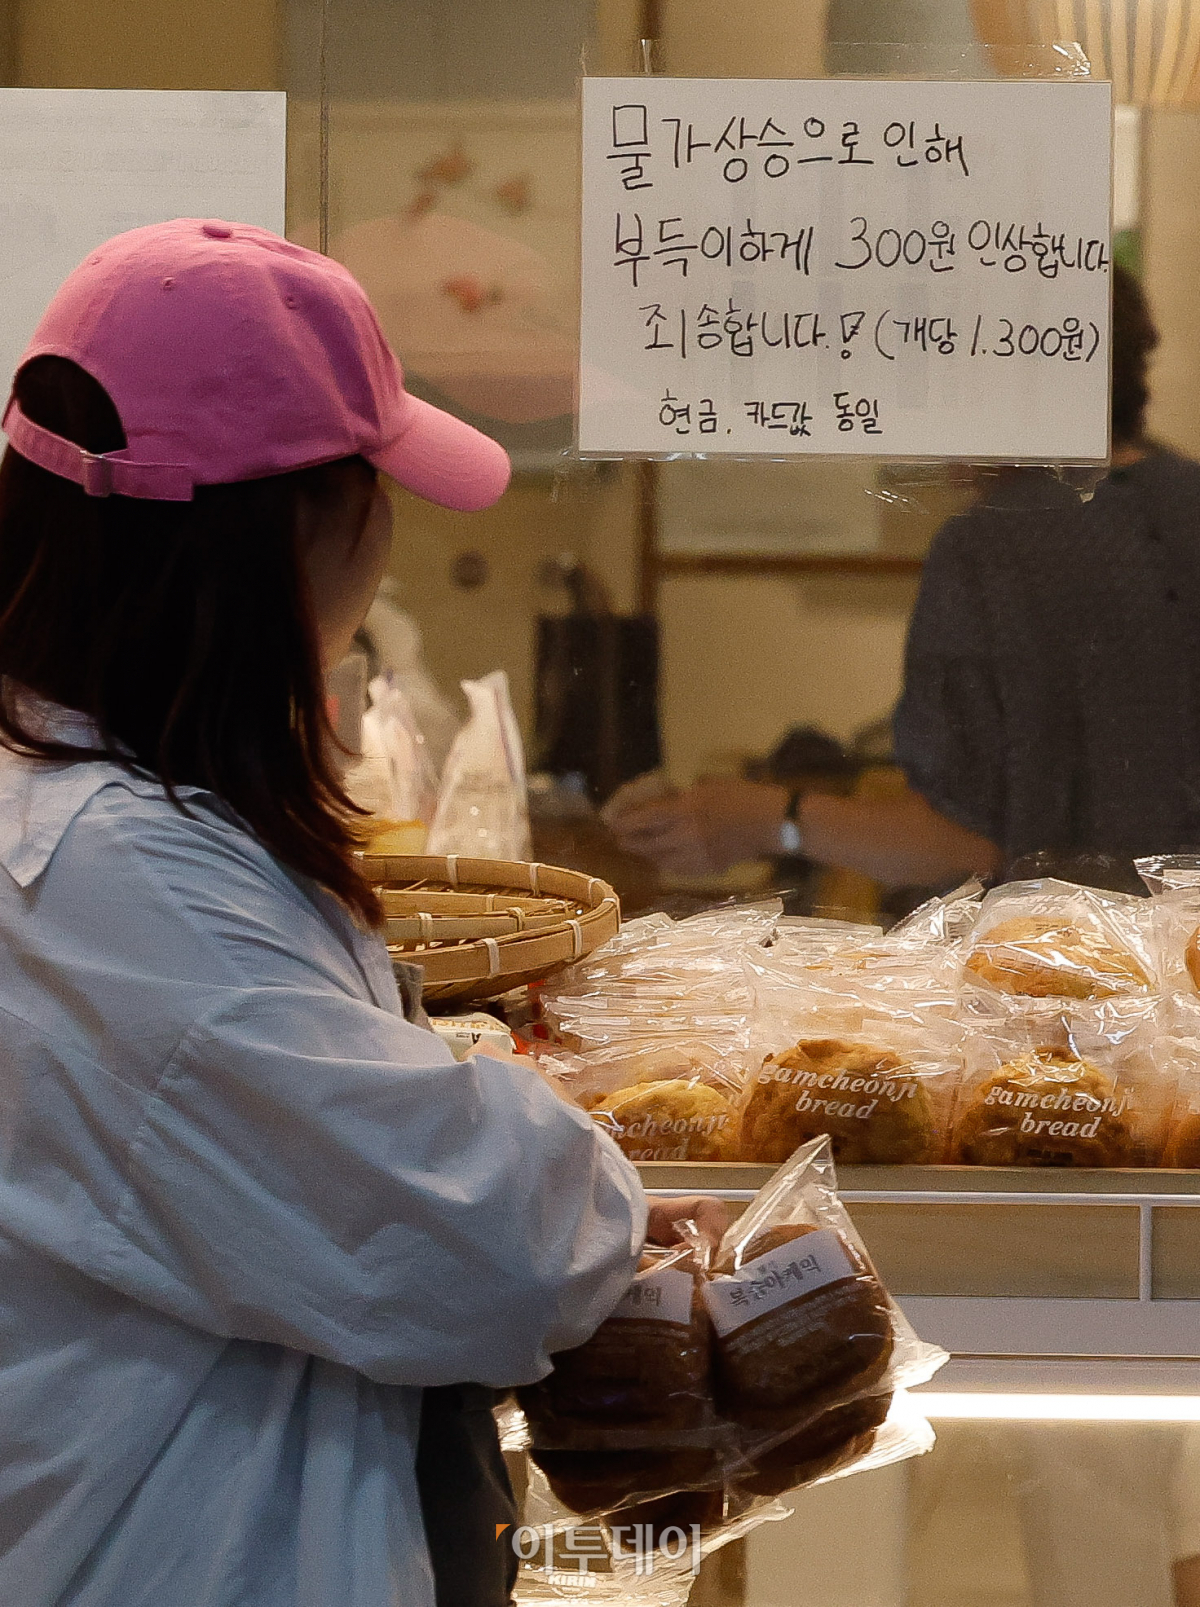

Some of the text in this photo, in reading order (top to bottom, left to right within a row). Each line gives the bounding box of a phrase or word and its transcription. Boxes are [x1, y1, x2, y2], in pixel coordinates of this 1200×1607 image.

[606, 104, 969, 190] 물가상승으로 인해
[613, 213, 1110, 287] 부득이하게 300원 인상합니다.
[875, 309, 959, 361] (개당
[970, 315, 1100, 363] 1.300원)
[832, 391, 884, 435] 동일
[795, 1089, 879, 1119] bread
[1020, 1112, 1102, 1138] bread
